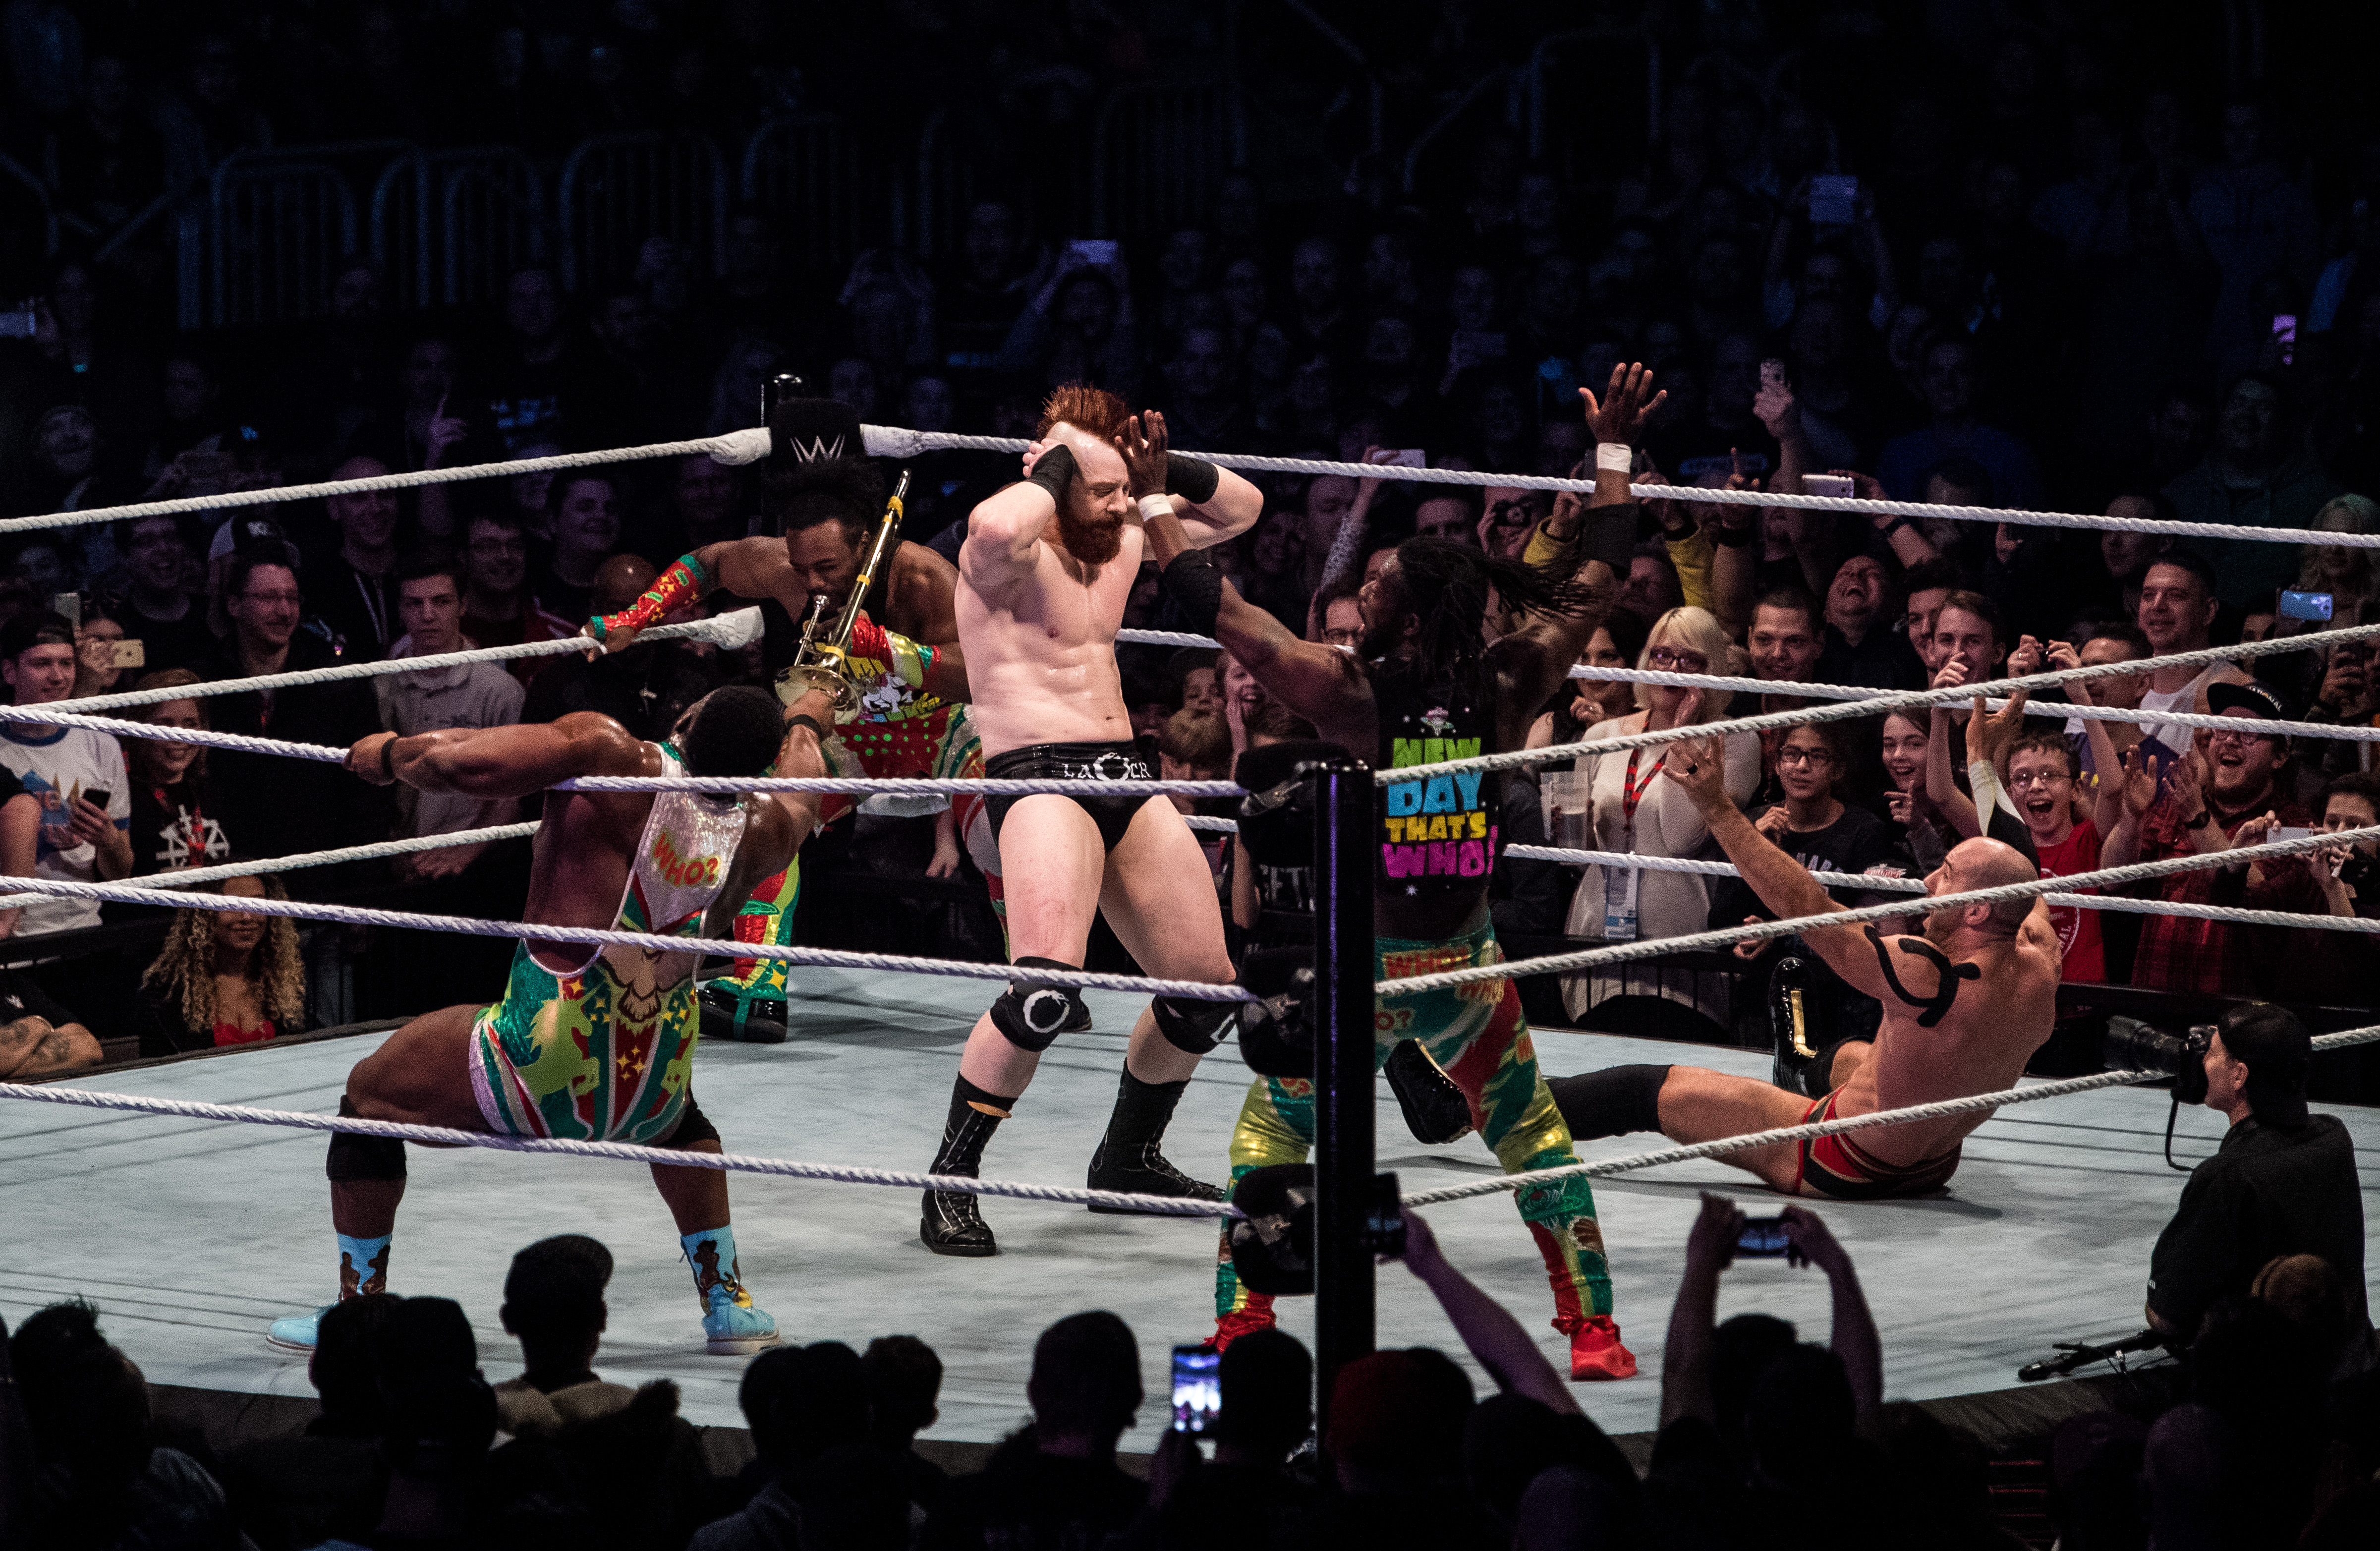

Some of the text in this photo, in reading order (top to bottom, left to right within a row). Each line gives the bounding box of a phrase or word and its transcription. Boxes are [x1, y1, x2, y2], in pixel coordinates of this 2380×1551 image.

[1392, 737, 1481, 768] NEW
[1387, 768, 1483, 816] DAY
[1385, 811, 1487, 843] THAT'S
[653, 832, 721, 886] WHO?
[1382, 825, 1498, 878] WHO!
